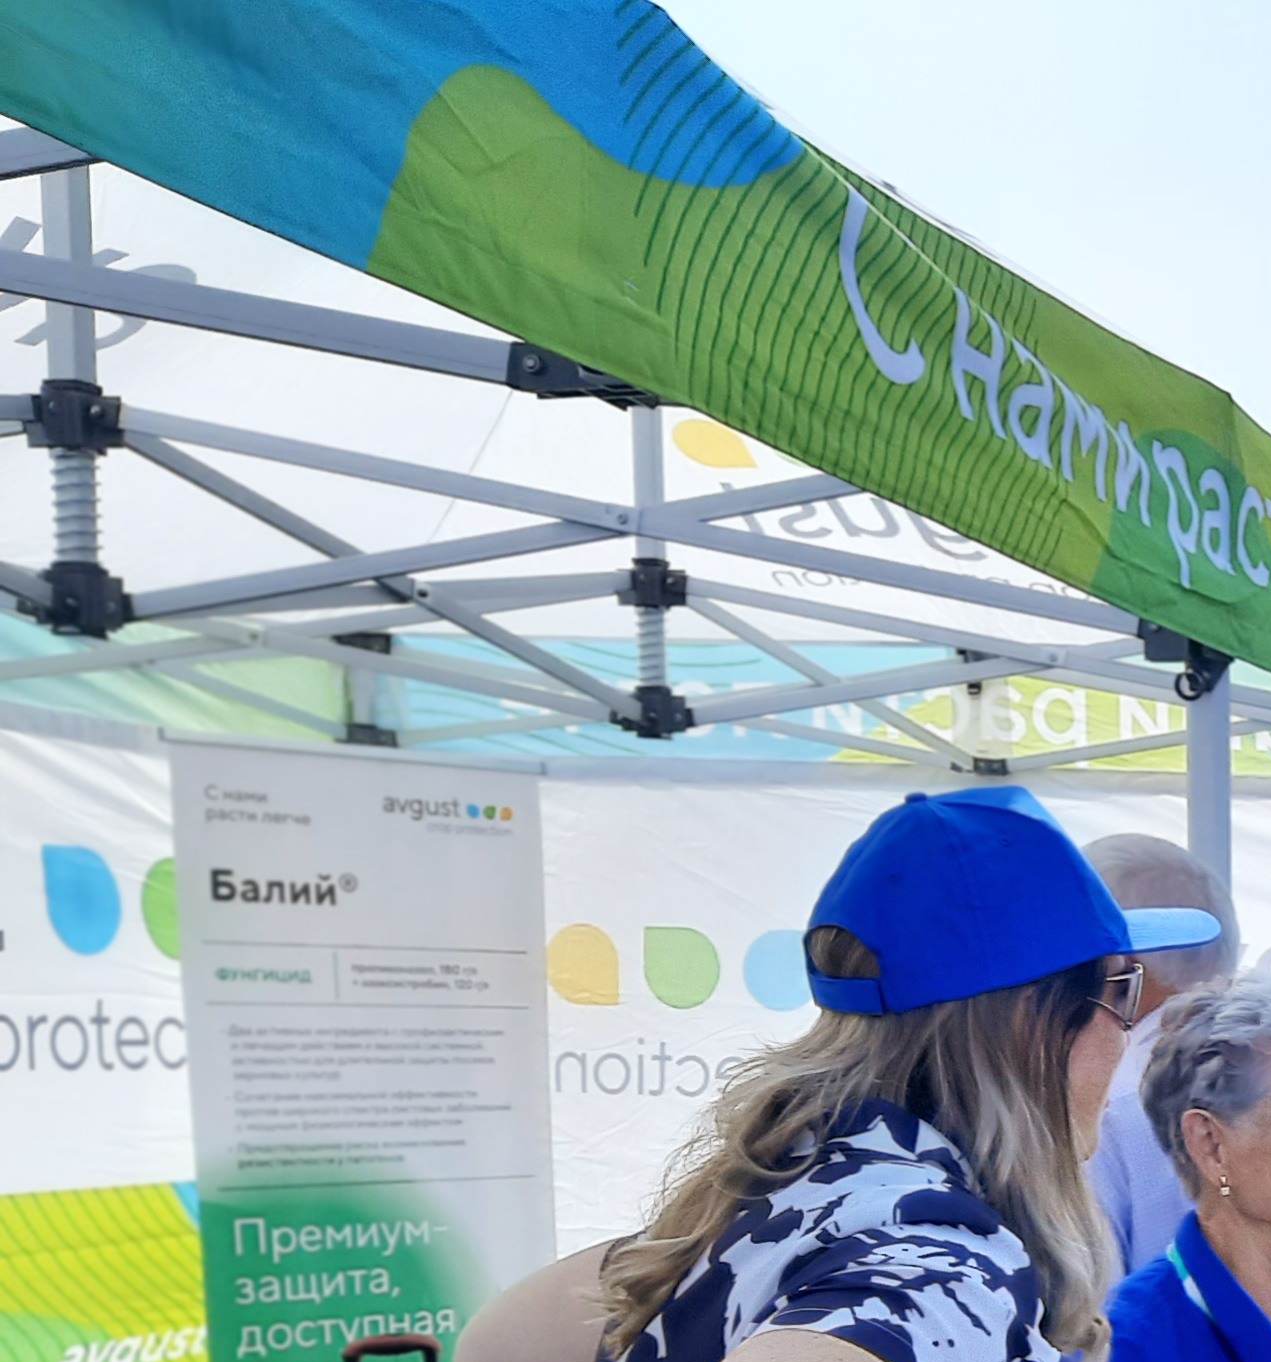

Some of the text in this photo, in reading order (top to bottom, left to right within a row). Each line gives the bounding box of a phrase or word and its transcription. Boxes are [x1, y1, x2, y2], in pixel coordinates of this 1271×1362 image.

[951, 287, 1152, 526] нами
[382, 796, 460, 820] avgust
[234, 1217, 448, 1264] Премиум-
[235, 1267, 400, 1304] защита,
[237, 1308, 455, 1358] доступная
